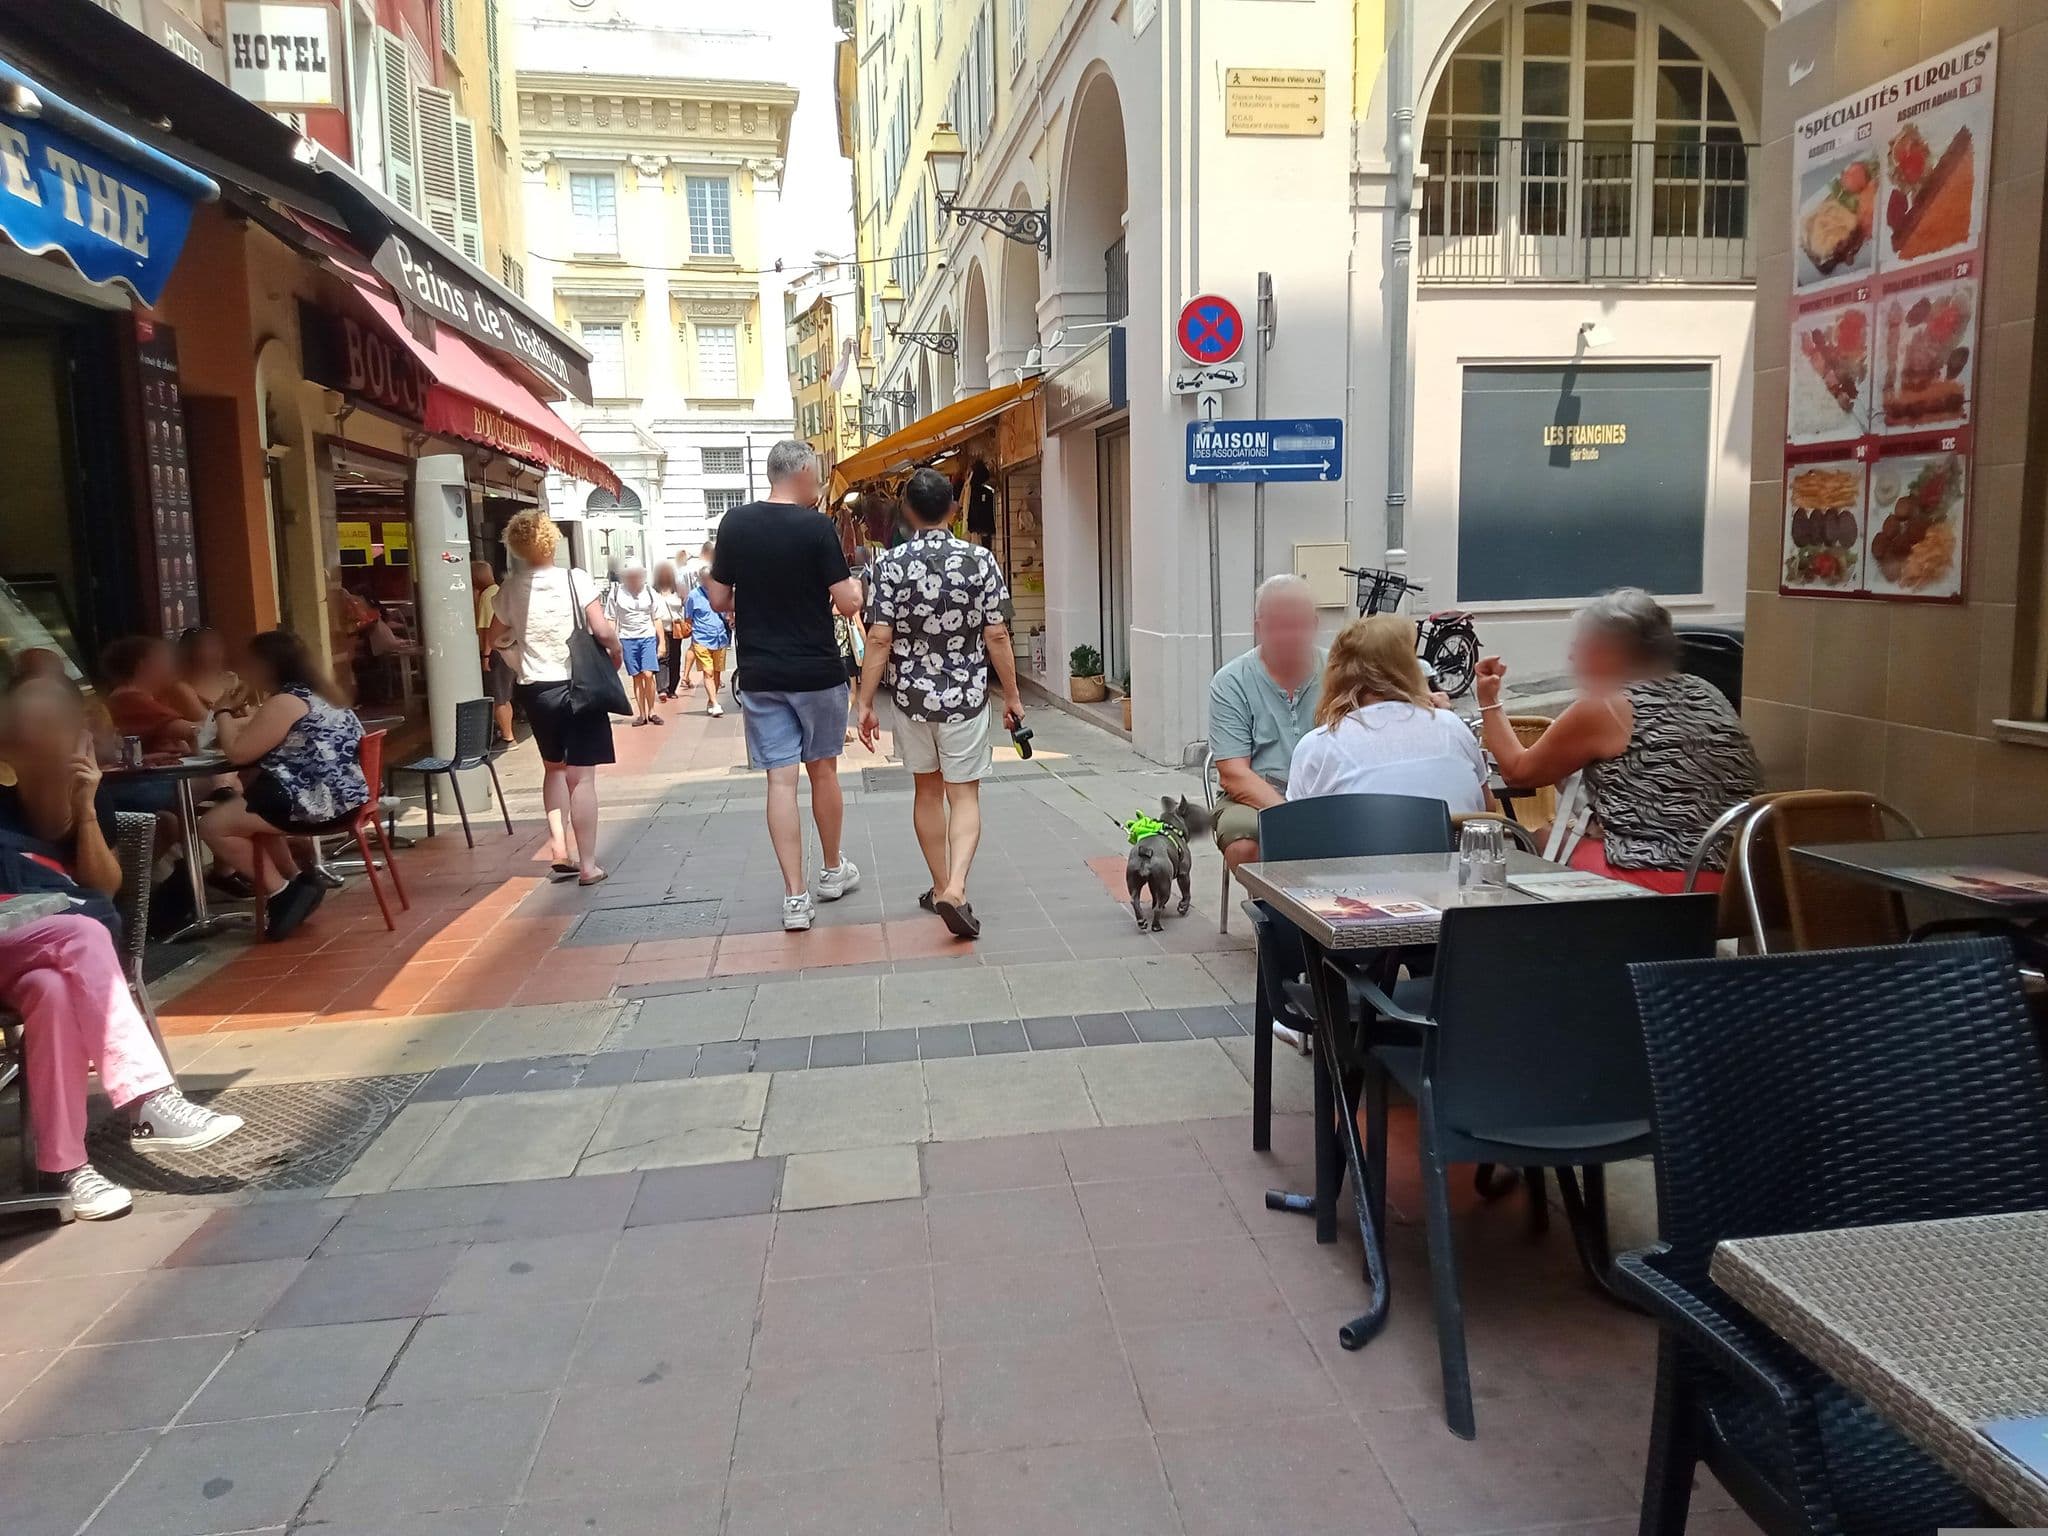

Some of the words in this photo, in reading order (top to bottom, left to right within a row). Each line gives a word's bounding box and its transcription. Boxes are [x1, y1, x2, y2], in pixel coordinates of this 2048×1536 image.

[233, 33, 327, 73] HOTEL
[1804, 84, 1900, 140] SPÉCIALITÉS
[1904, 45, 1987, 97] TURQUES
[46, 146, 149, 258] THE
[392, 234, 469, 322] Pains
[473, 290, 504, 340] de
[499, 306, 570, 385] Tradition
[473, 406, 532, 453] BOUCHERIE
[1195, 432, 1266, 449] MAISON
[1544, 425, 1564, 446] LES
[1566, 424, 1627, 445] FRANGINES
[1212, 448, 1266, 458] ASSOCIATIONS
